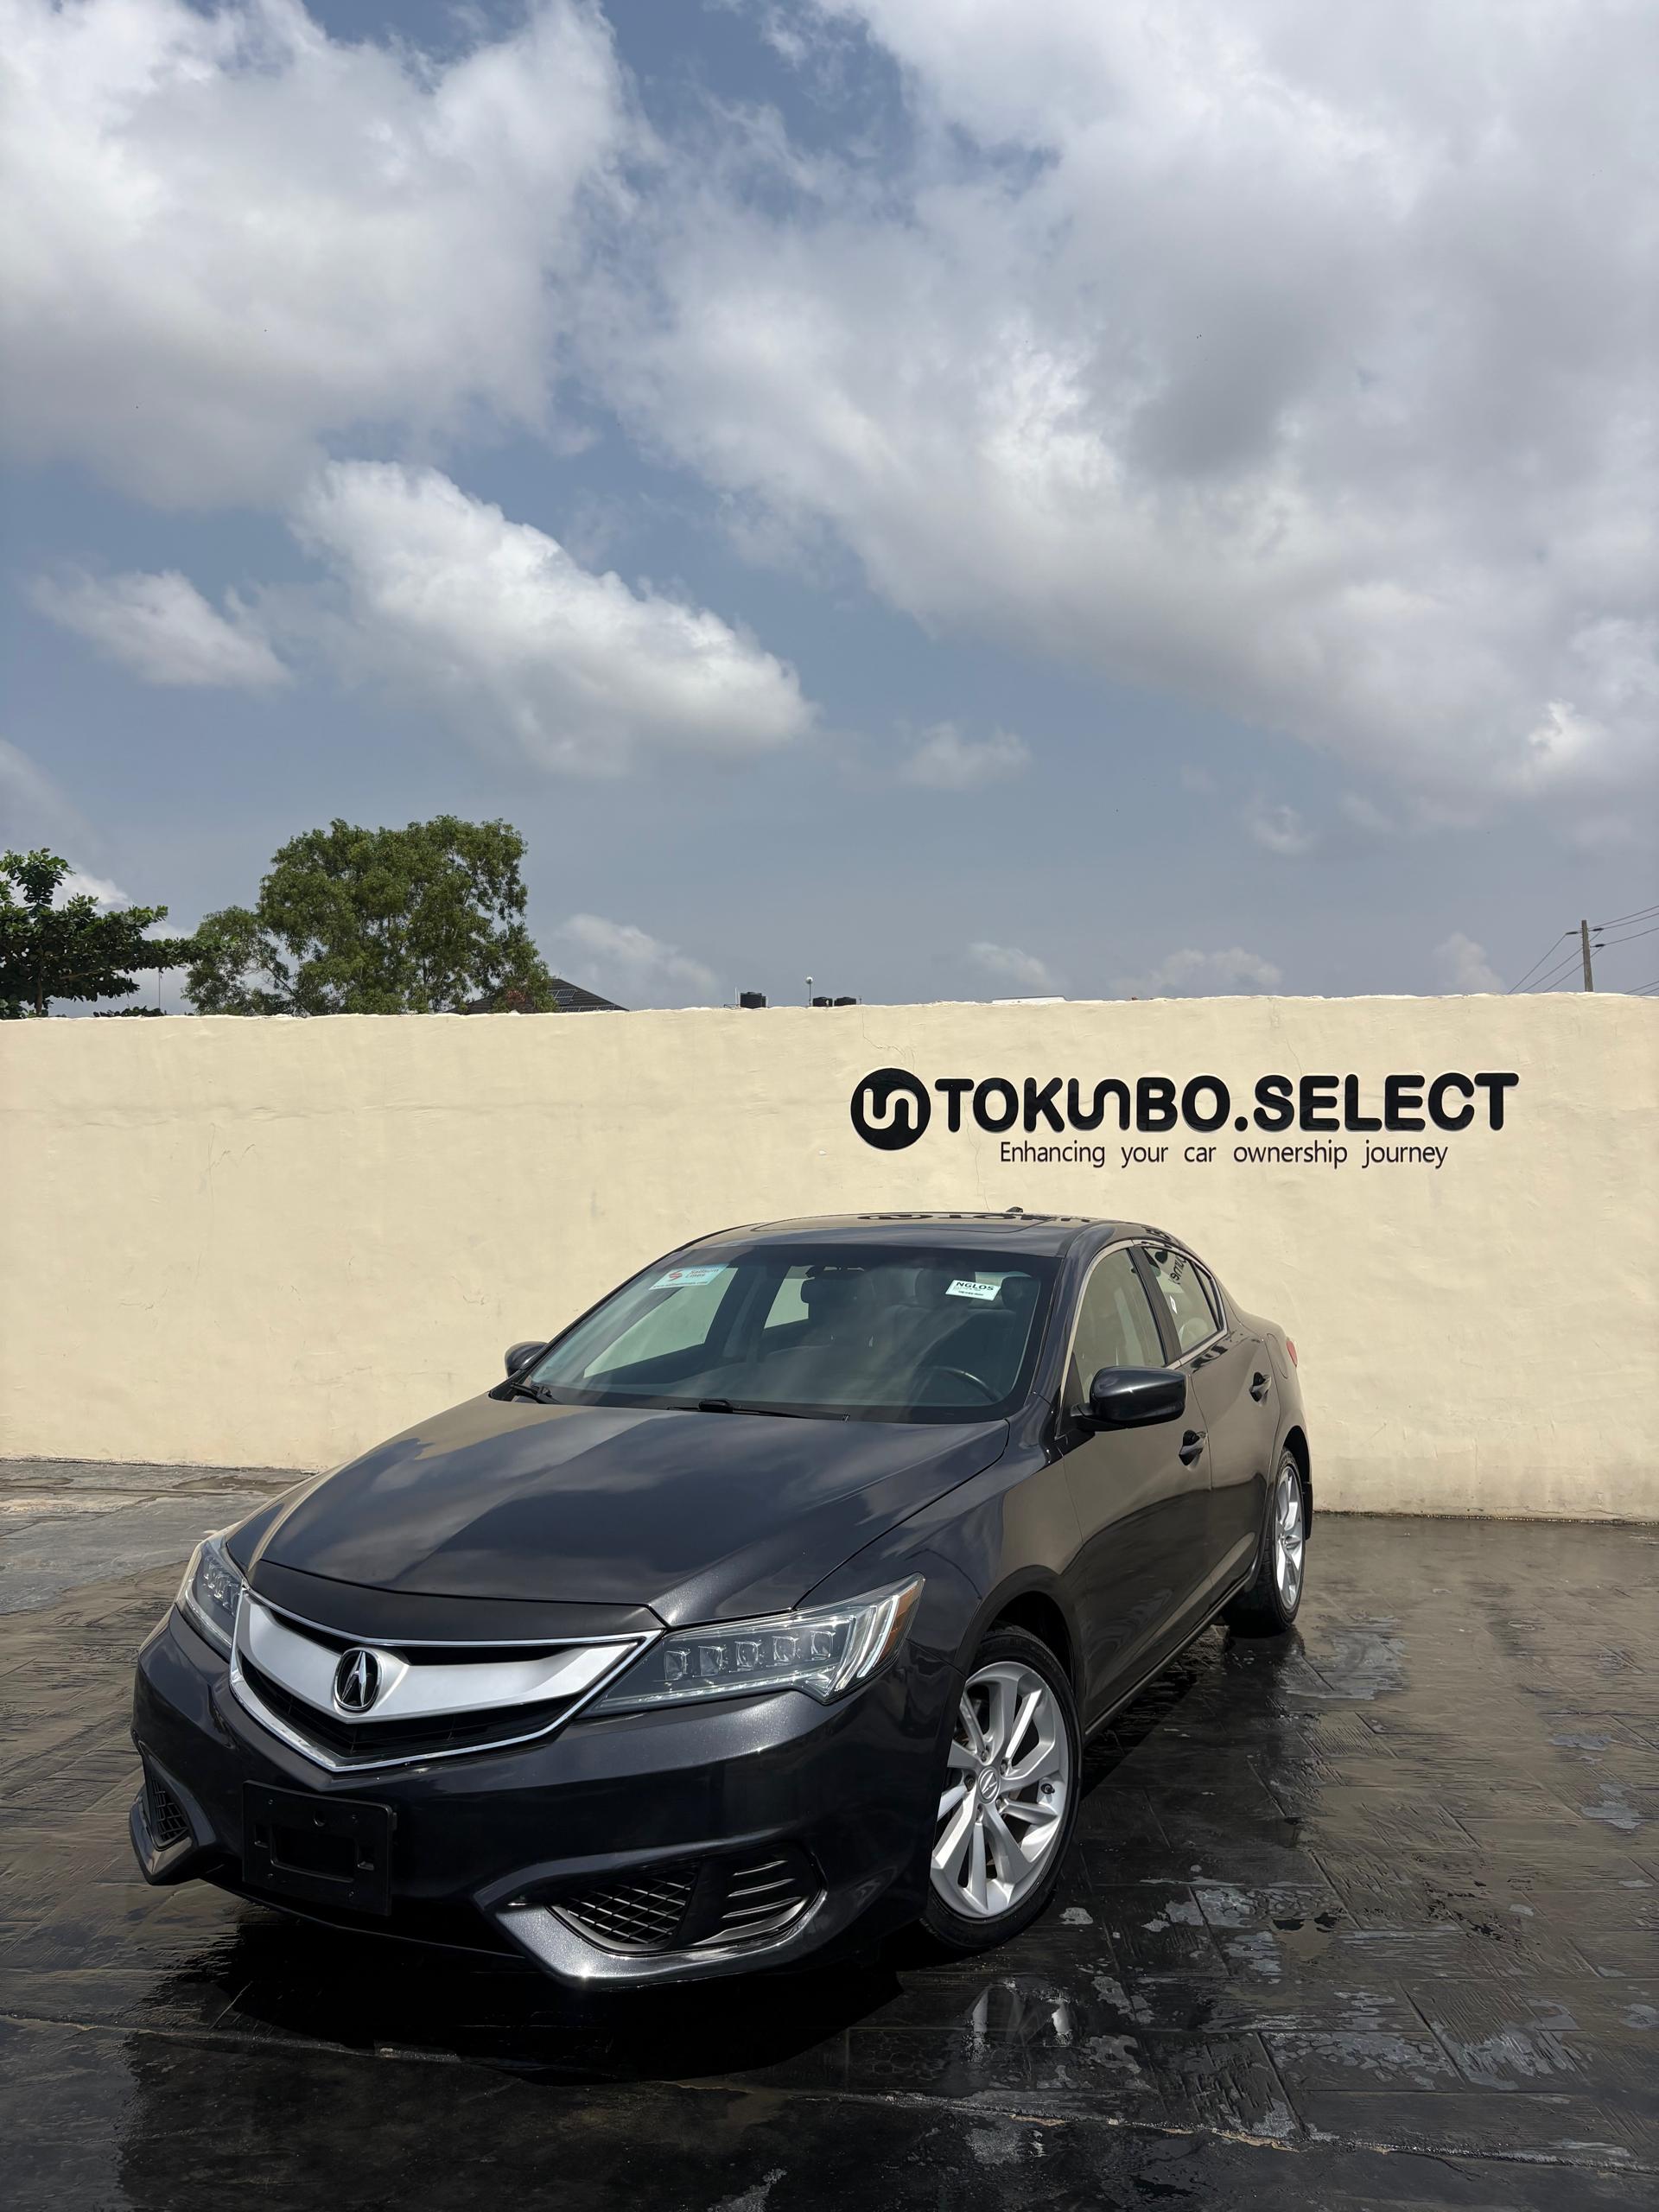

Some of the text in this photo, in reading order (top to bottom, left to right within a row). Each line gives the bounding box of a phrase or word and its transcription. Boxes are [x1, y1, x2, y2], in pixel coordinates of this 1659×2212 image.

[1001, 1139, 1449, 1170] Enhancing your car ownership journey
[956, 1281, 995, 1291] NGLOS
